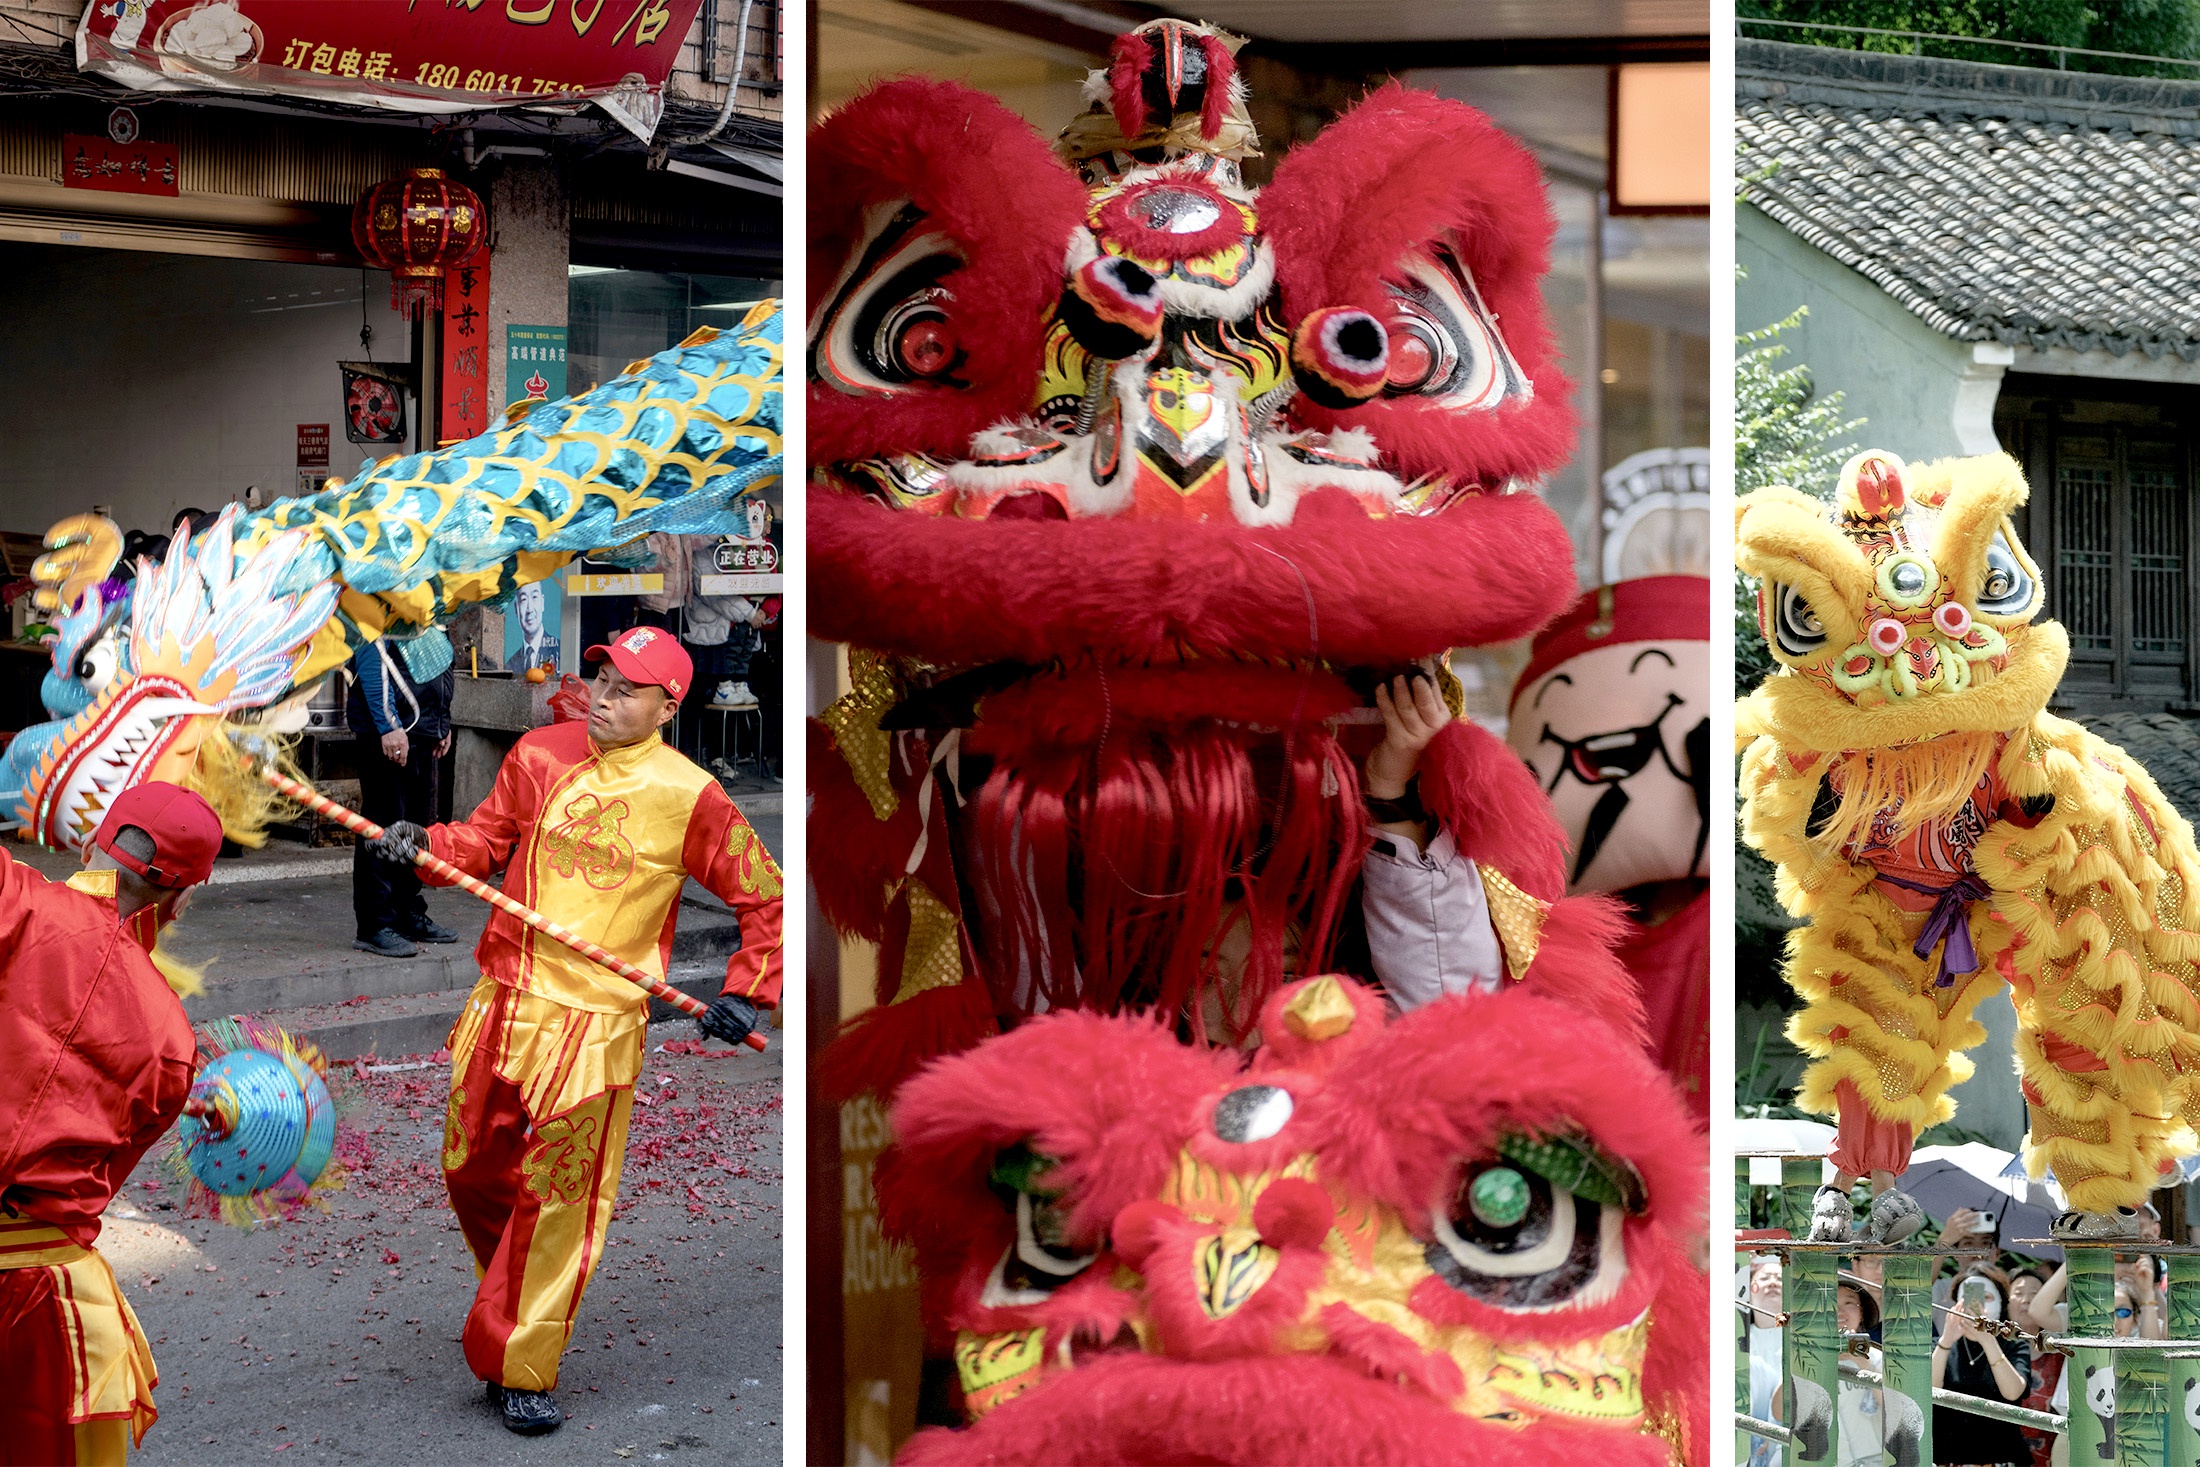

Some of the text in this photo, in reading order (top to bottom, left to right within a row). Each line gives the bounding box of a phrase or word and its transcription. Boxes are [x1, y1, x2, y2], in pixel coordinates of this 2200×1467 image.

[416, 62, 460, 90] 180
[511, 345, 566, 362] 高端管道典范
[719, 549, 775, 566] 正在营业
